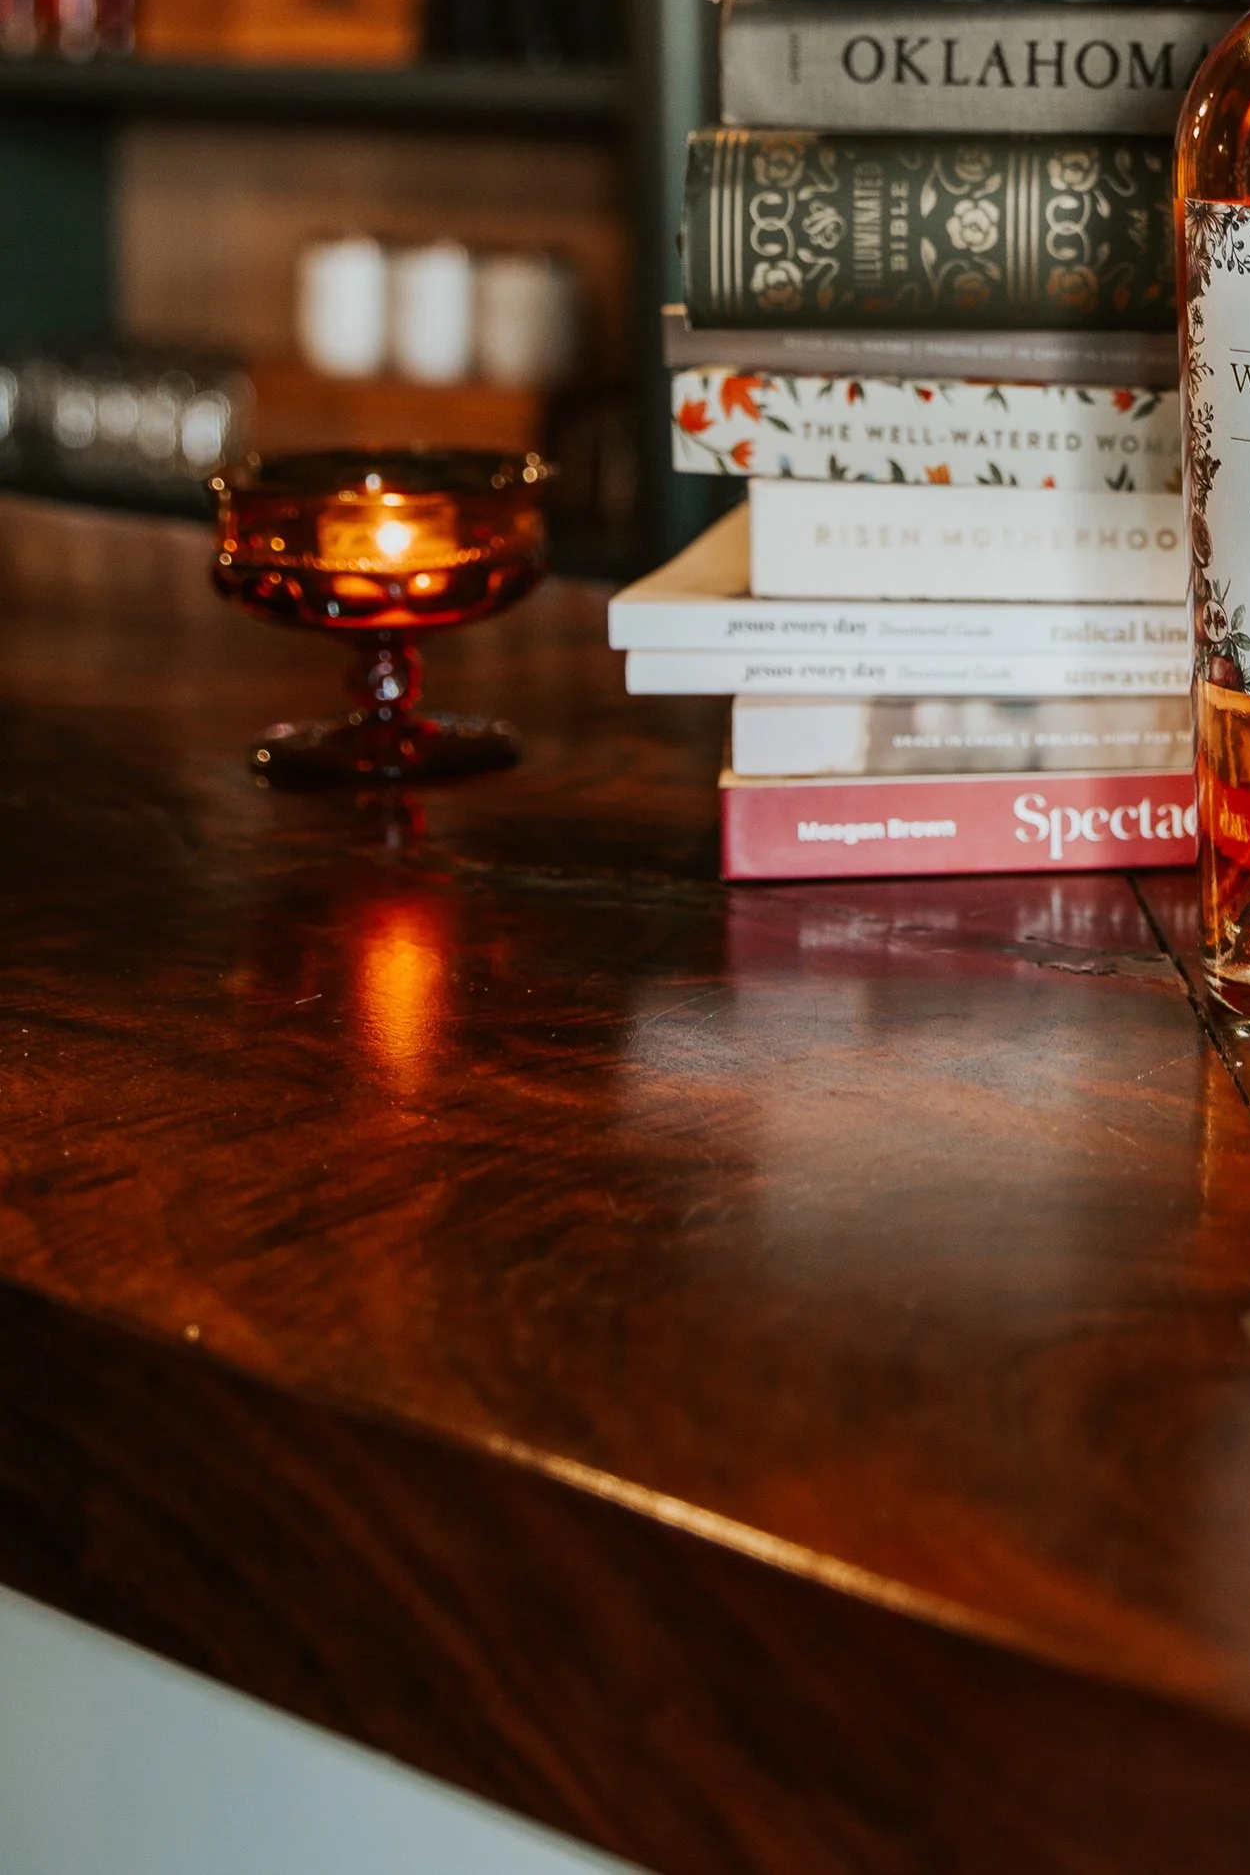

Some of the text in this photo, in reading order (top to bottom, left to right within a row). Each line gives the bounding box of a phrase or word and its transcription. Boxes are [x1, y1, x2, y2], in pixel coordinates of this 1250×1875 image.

[889, 180, 909, 272] BIBLE
[801, 422, 850, 442] THE
[864, 424, 1083, 452] WELL-WATERED
[939, 526, 1179, 552] MOTHERHOO
[1064, 666, 1188, 686] unwaveri
[887, 818, 957, 839] Brown
